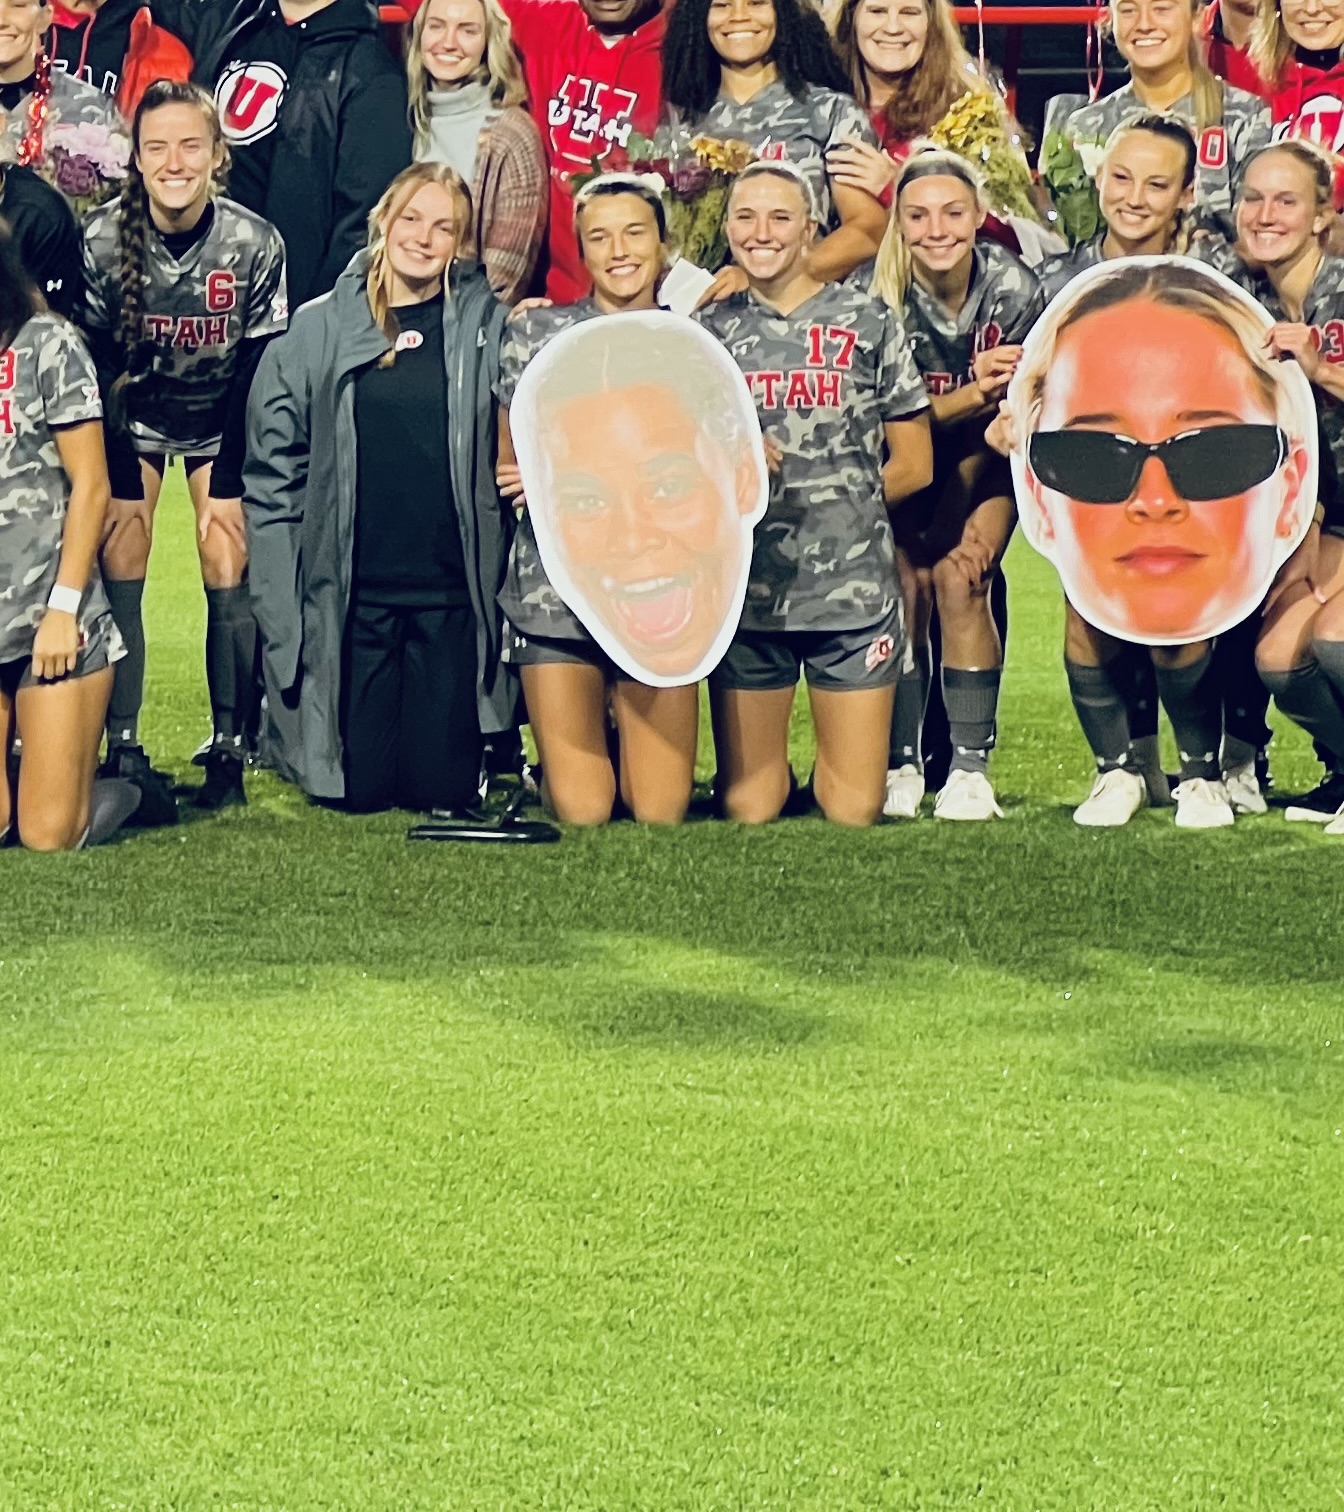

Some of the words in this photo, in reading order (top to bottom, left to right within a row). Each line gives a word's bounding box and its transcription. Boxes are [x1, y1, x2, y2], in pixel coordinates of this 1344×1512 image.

[225, 74, 279, 131] U
[205, 269, 237, 312] 6
[142, 313, 229, 347] TAH
[805, 323, 858, 370] 17
[748, 369, 843, 409] TAH
